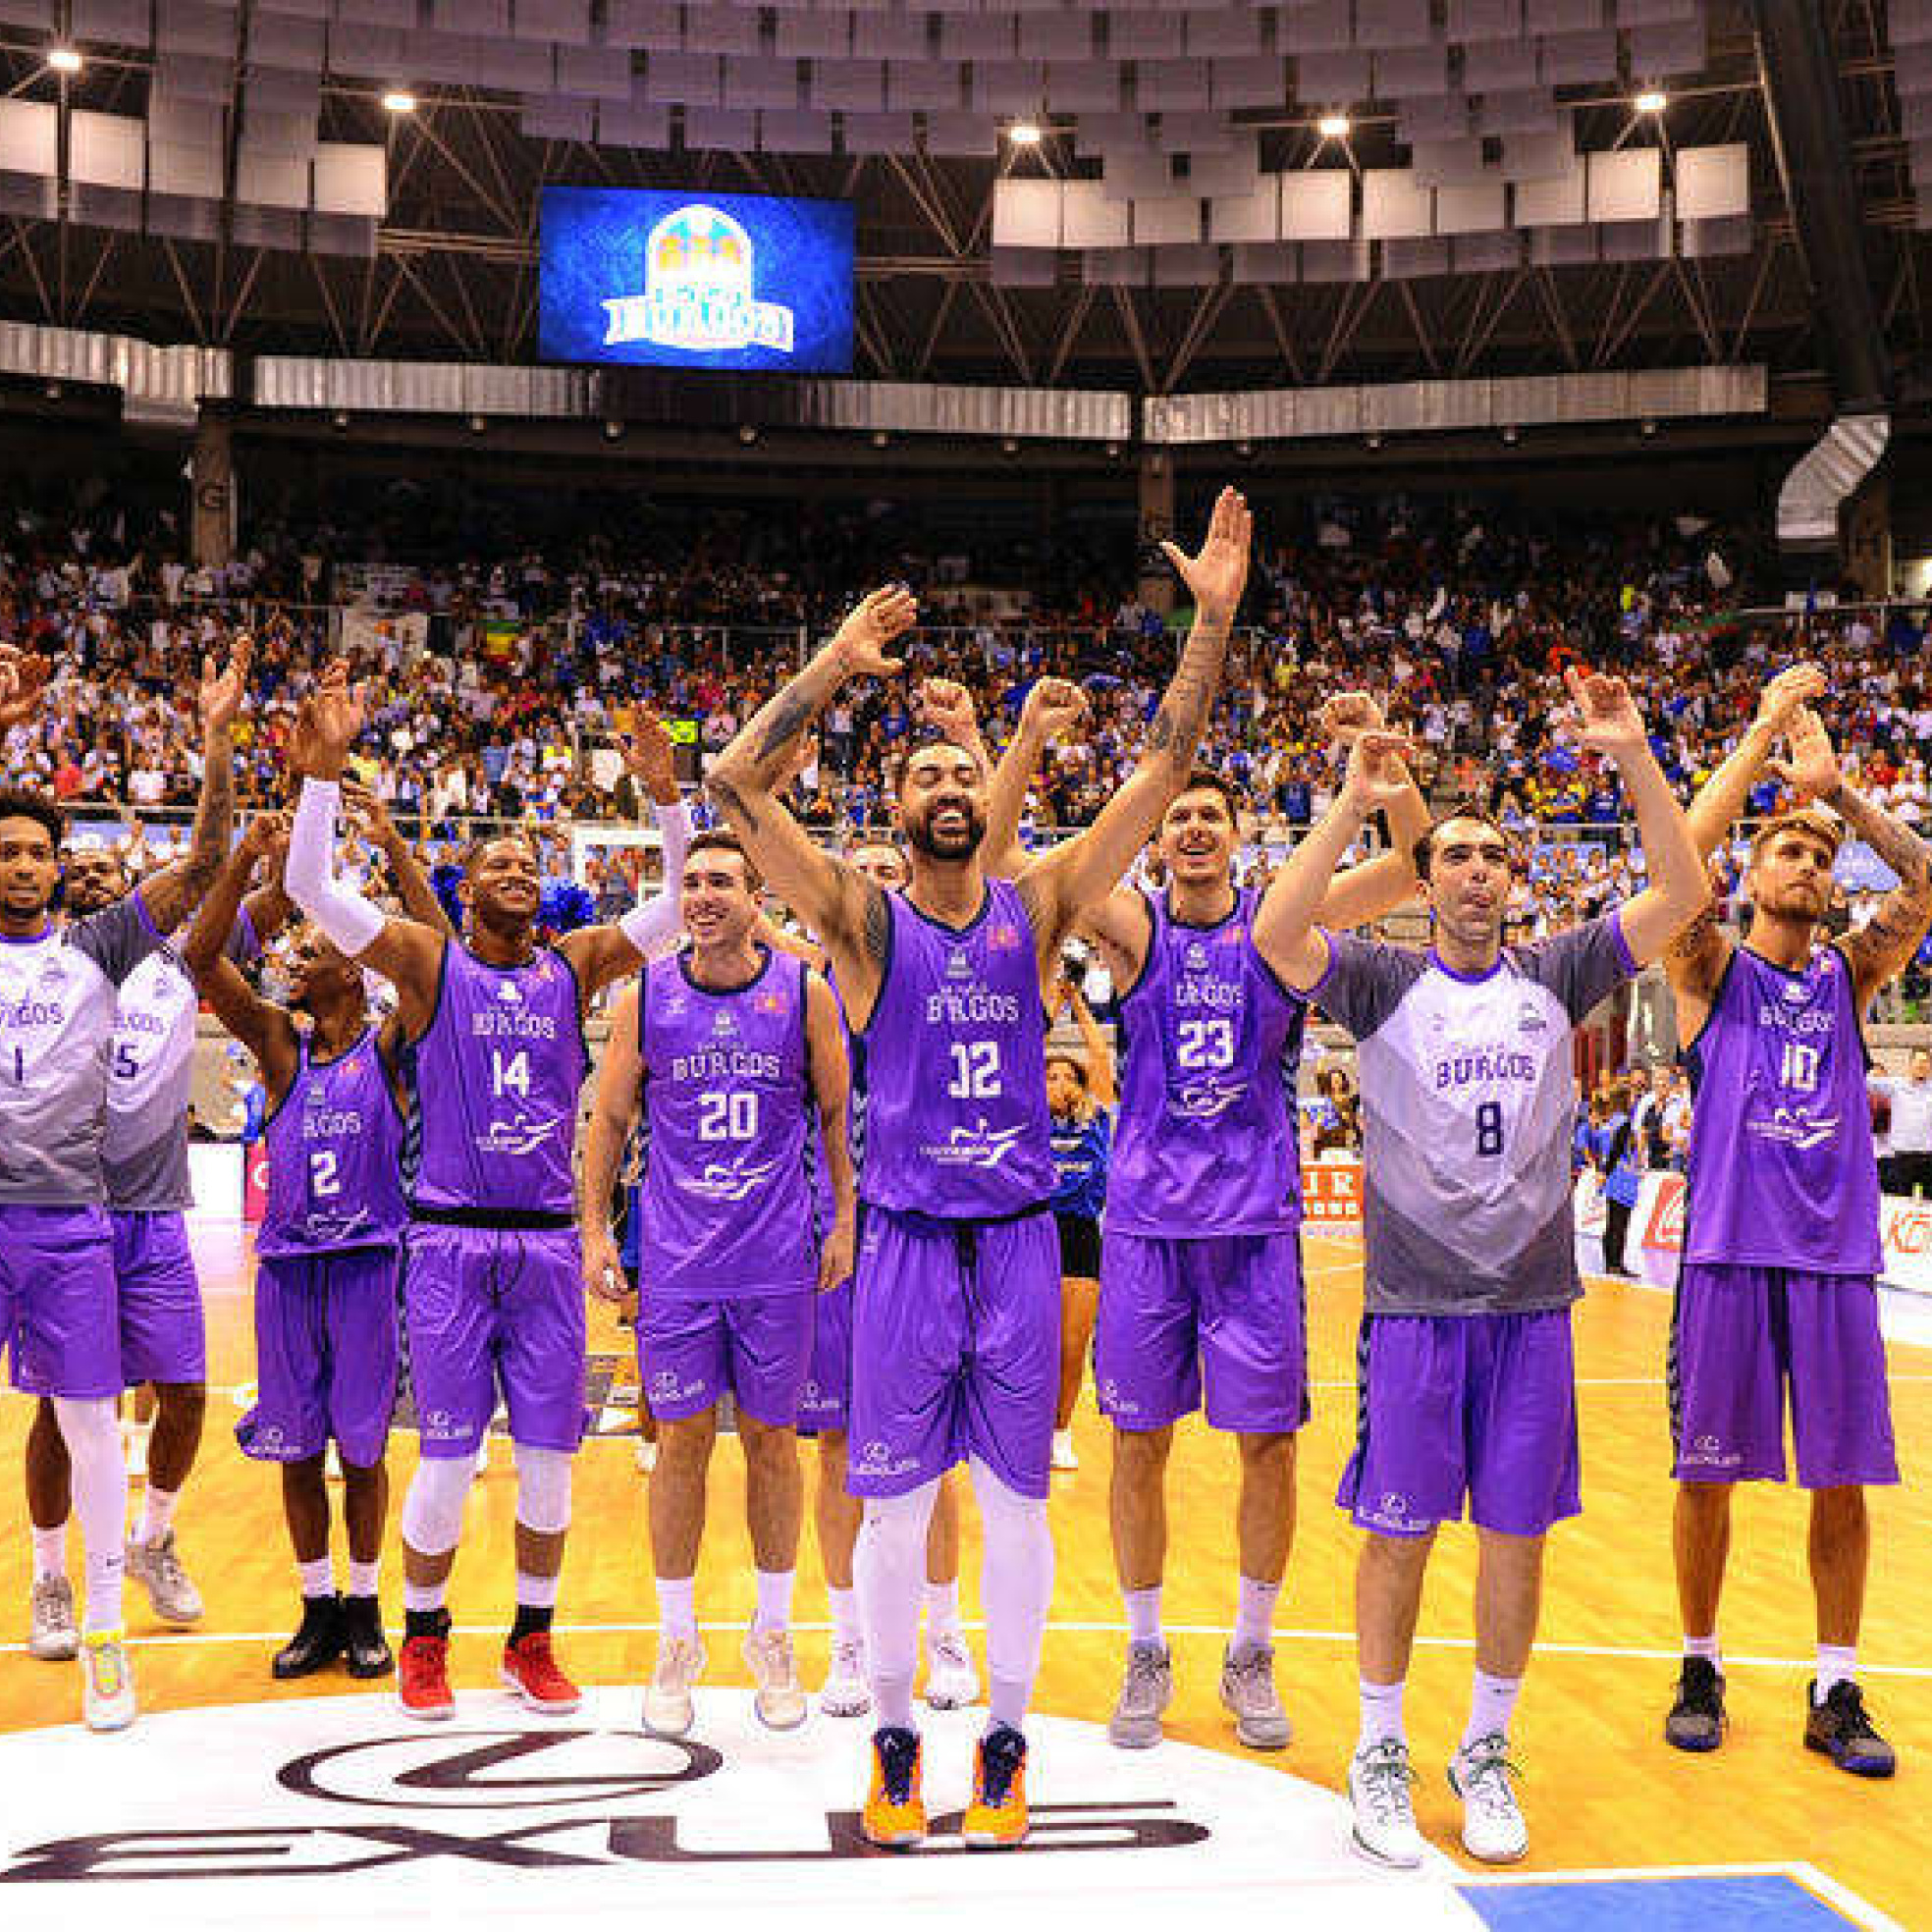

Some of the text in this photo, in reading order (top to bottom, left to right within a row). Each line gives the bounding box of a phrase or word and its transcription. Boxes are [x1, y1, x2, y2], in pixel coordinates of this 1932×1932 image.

[115, 1044, 139, 1078] 5
[672, 1053, 780, 1081] BURGOS
[1177, 1020, 1235, 1067] 23
[493, 1050, 530, 1097] 14
[947, 1041, 1002, 1100] 12
[1435, 1050, 1536, 1089] BURGOS
[1779, 1044, 1818, 1092] 10
[697, 1092, 759, 1142] 20
[1476, 1101, 1503, 1156] 8
[309, 1150, 341, 1197] 2
